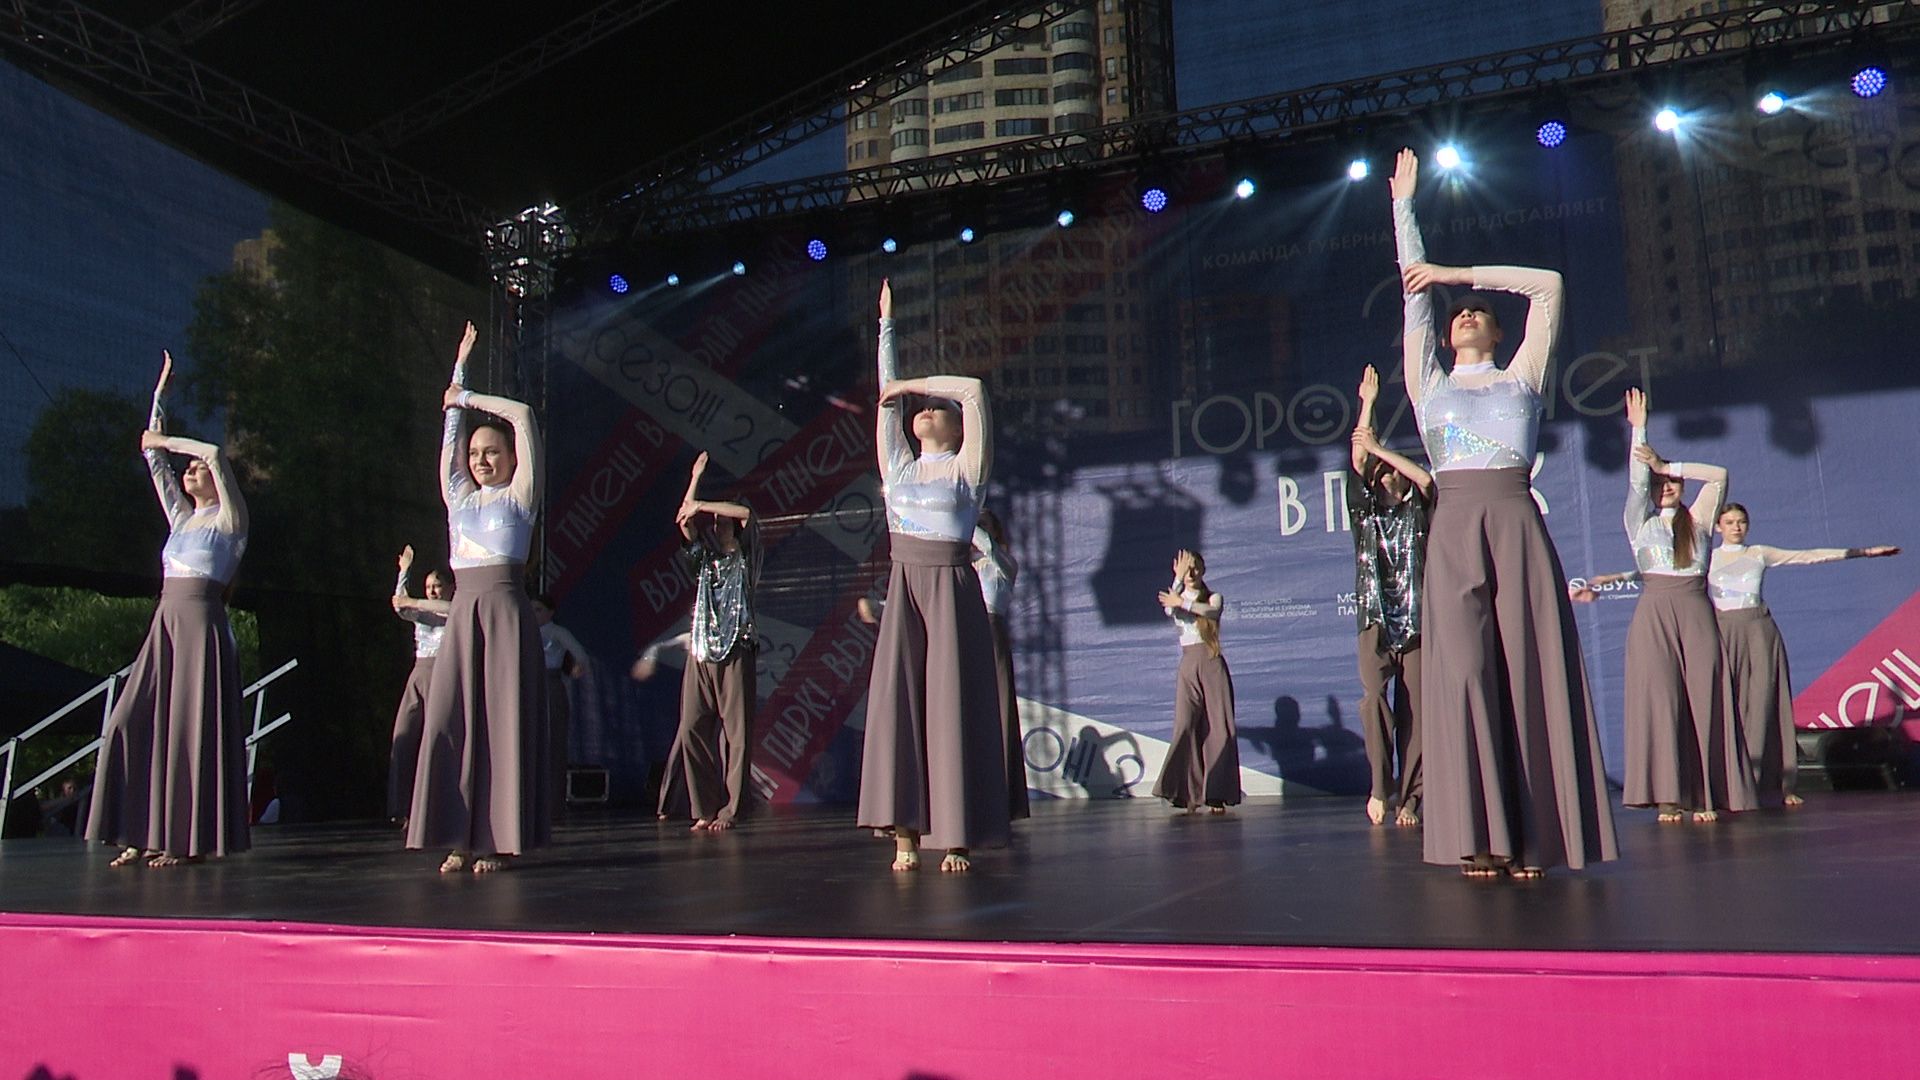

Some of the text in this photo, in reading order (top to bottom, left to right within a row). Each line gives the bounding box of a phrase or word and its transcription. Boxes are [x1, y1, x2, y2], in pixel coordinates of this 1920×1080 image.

[1202, 197, 1607, 269] КОМАНДА ГУБЕРНАРА ПРЕДСТАВЛЯЕТ
[1171, 383, 1351, 458] ГОРО
[1278, 475, 1308, 536] В
[761, 677, 837, 769] ПАРК!
